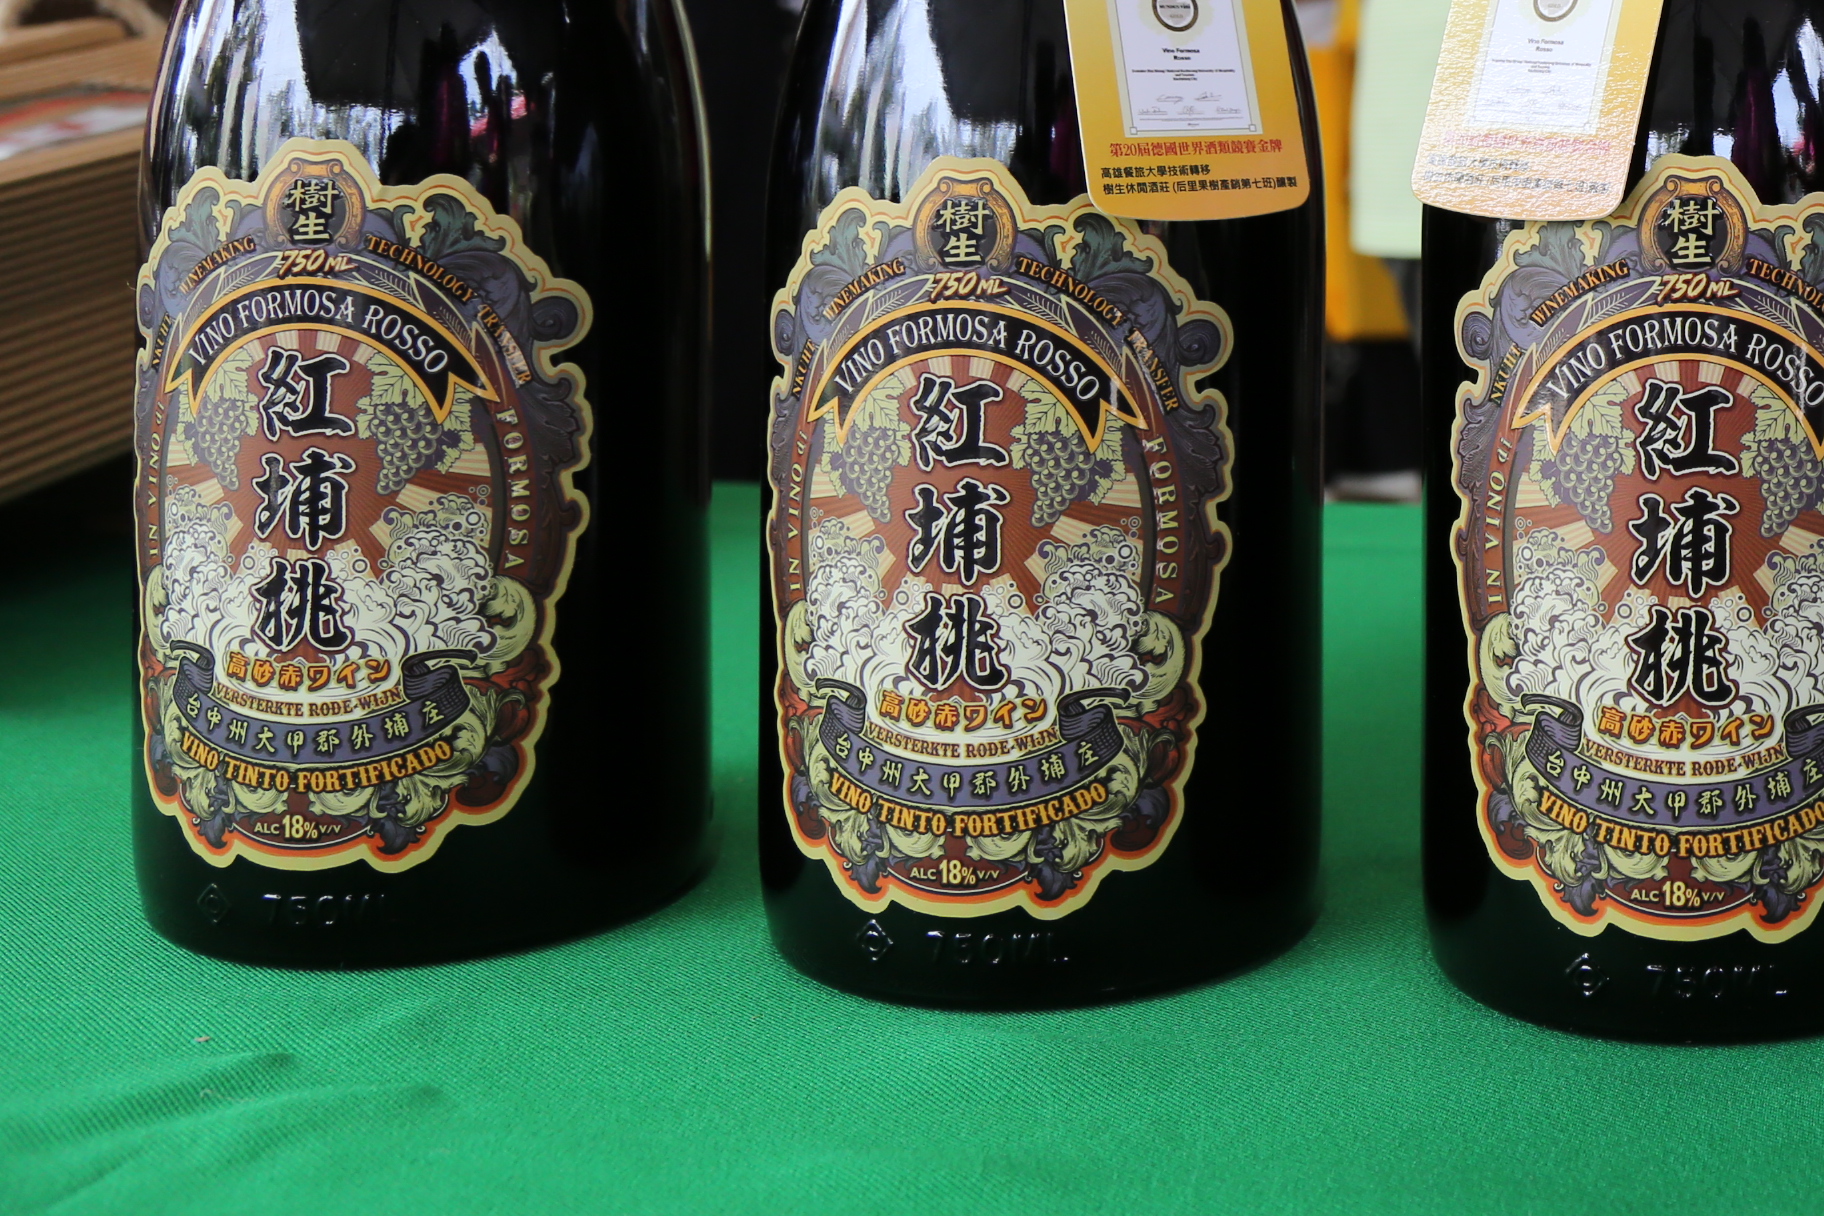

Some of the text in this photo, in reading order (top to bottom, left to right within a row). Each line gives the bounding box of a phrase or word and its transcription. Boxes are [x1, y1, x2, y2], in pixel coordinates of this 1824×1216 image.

[288, 178, 338, 243] 樹生
[938, 199, 990, 265] 樹生
[1665, 198, 1719, 266] 樹生
[276, 249, 325, 277] 750
[928, 272, 976, 302] 750
[1530, 259, 1630, 328] WINEMAKING
[1655, 273, 1706, 304] 750
[178, 233, 533, 385] WINEMAKING TECHNOLOGY TRANSFER
[188, 290, 448, 374] VINO FORMOSA ROSSO
[822, 257, 906, 322] WINEMAKING
[1018, 257, 1127, 328] TECHNOLOGY
[1128, 328, 1180, 413] TRANSFER
[833, 315, 1101, 402] VINO FORMOSA ROSSO
[1548, 341, 1606, 399] VINO
[1610, 318, 1737, 358] FORMOSA
[214, 683, 304, 717] VERSTERKTE
[225, 651, 391, 688] 高砂赤ワイン
[186, 692, 445, 755] 台中州大甲郡外埔庄
[866, 723, 960, 758] VERSTERKTE
[878, 690, 1048, 731] 高砂赤ワイン
[1598, 705, 1776, 747] 高砂赤ワイン
[179, 732, 453, 794] VINO TINTO FORTIFICADO
[834, 733, 1100, 798] 台中州大甲郡外埔庄
[1545, 750, 1824, 817] 台中州大甲郡外埔庄
[1584, 740, 1686, 776] VERSTERKTE
[254, 821, 279, 835] ALC
[282, 815, 317, 840] 18%
[828, 773, 1108, 838] VINO TINTO FORTIFICADO
[1539, 790, 1587, 832] VINO
[1596, 817, 1669, 856] TINTO
[910, 867, 937, 880] ALC
[939, 861, 976, 885] 18%
[1631, 888, 1659, 902] ALC
[1661, 881, 1700, 908] 18%
